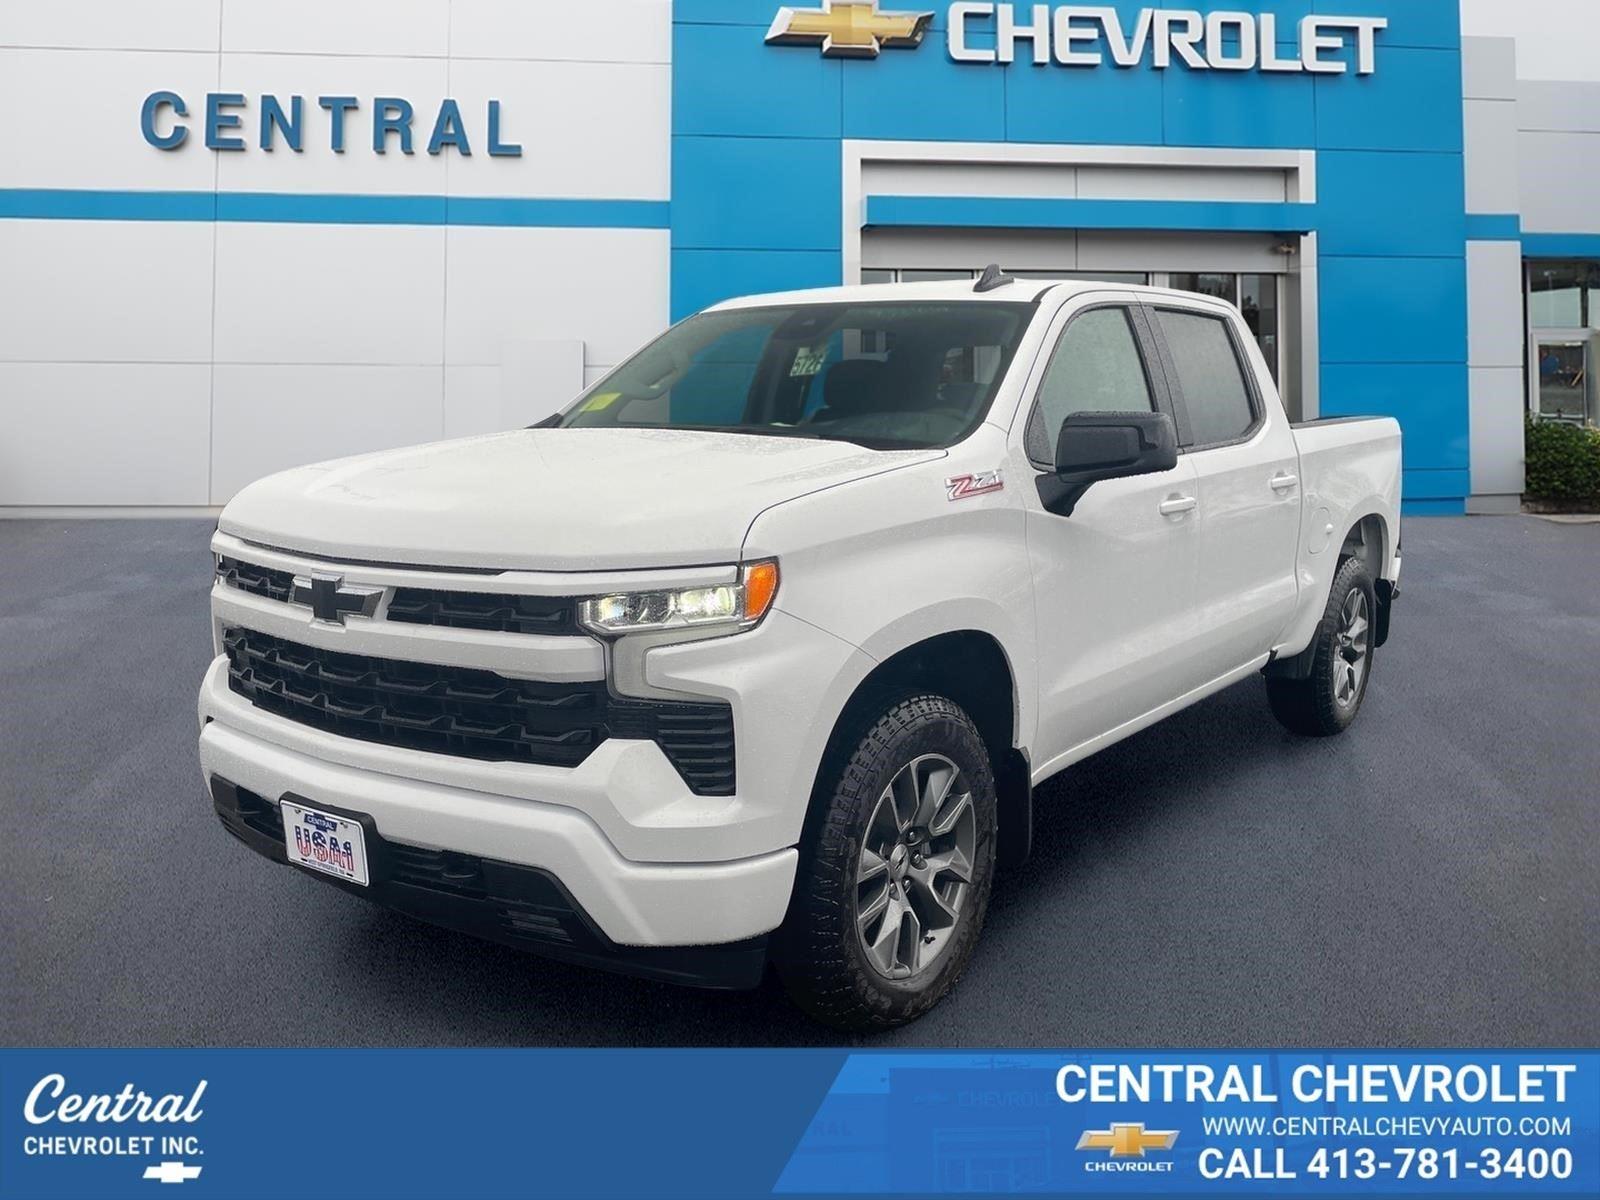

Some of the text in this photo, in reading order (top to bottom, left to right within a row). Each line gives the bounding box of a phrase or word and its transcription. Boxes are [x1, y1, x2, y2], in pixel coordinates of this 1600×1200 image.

[947, 1, 1389, 76] CHEVROLET
[140, 90, 523, 158] CENTRAL
[944, 468, 1004, 502] Z71
